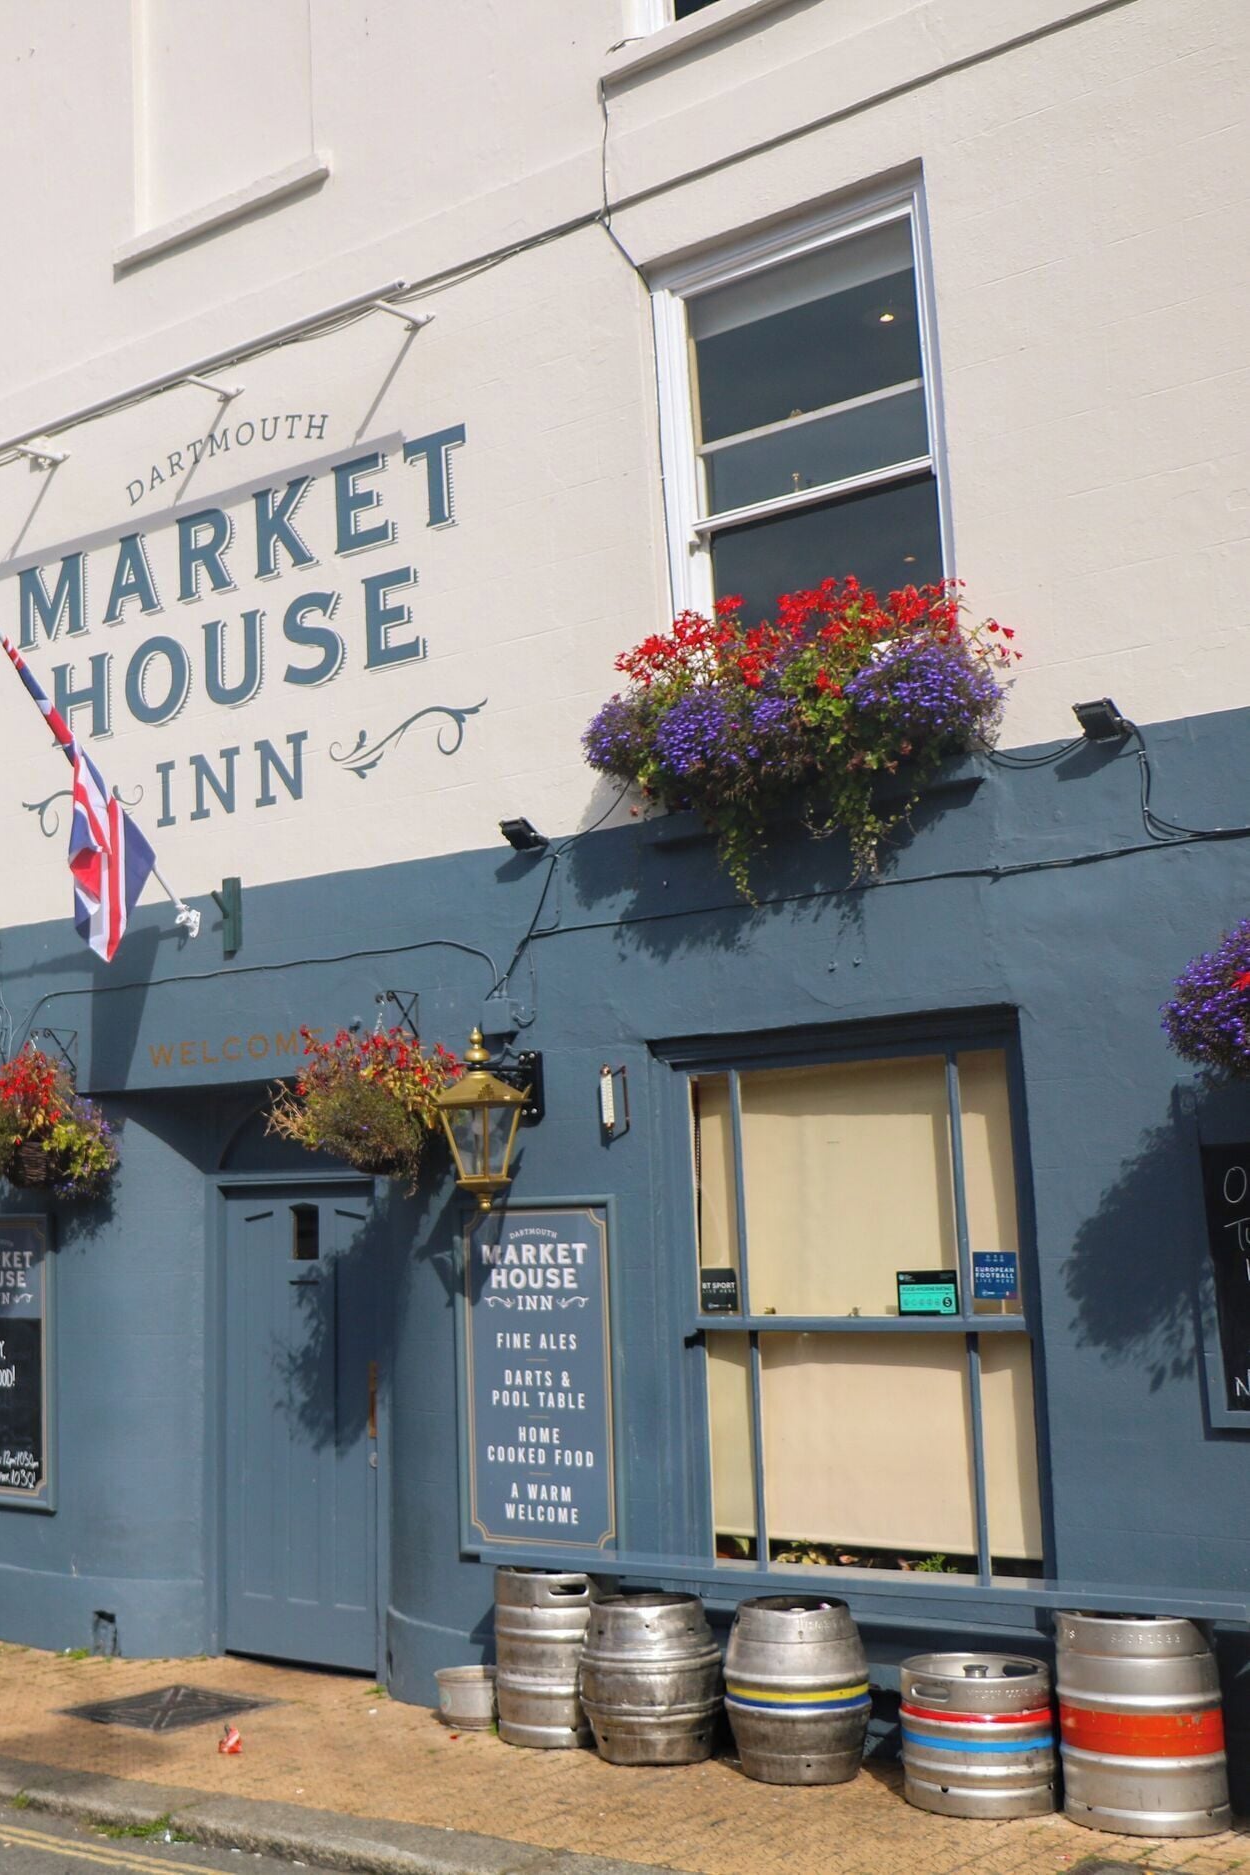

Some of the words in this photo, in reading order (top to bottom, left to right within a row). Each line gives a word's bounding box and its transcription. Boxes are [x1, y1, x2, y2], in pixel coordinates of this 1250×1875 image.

[126, 414, 329, 505] DARTMOUTH
[18, 423, 466, 651] MARKET
[52, 566, 429, 747] HOUSE
[156, 730, 308, 828] INN
[509, 1228, 558, 1240] DARTMOUTH
[481, 1243, 588, 1265] MARKET
[490, 1268, 579, 1289] HOUSE
[517, 1295, 553, 1311] INN
[496, 1332, 531, 1349] FINE
[539, 1333, 577, 1350] ALES
[504, 1369, 553, 1386] DARTS
[561, 1371, 571, 1387] &
[492, 1390, 530, 1407] POOL
[538, 1391, 586, 1409] TABLE
[518, 1426, 561, 1444] HOME
[487, 1445, 546, 1464] COOKED
[554, 1449, 594, 1467] FOOD
[511, 1482, 519, 1499] A
[527, 1483, 572, 1503] WARM
[505, 1503, 579, 1524] WELCOME
